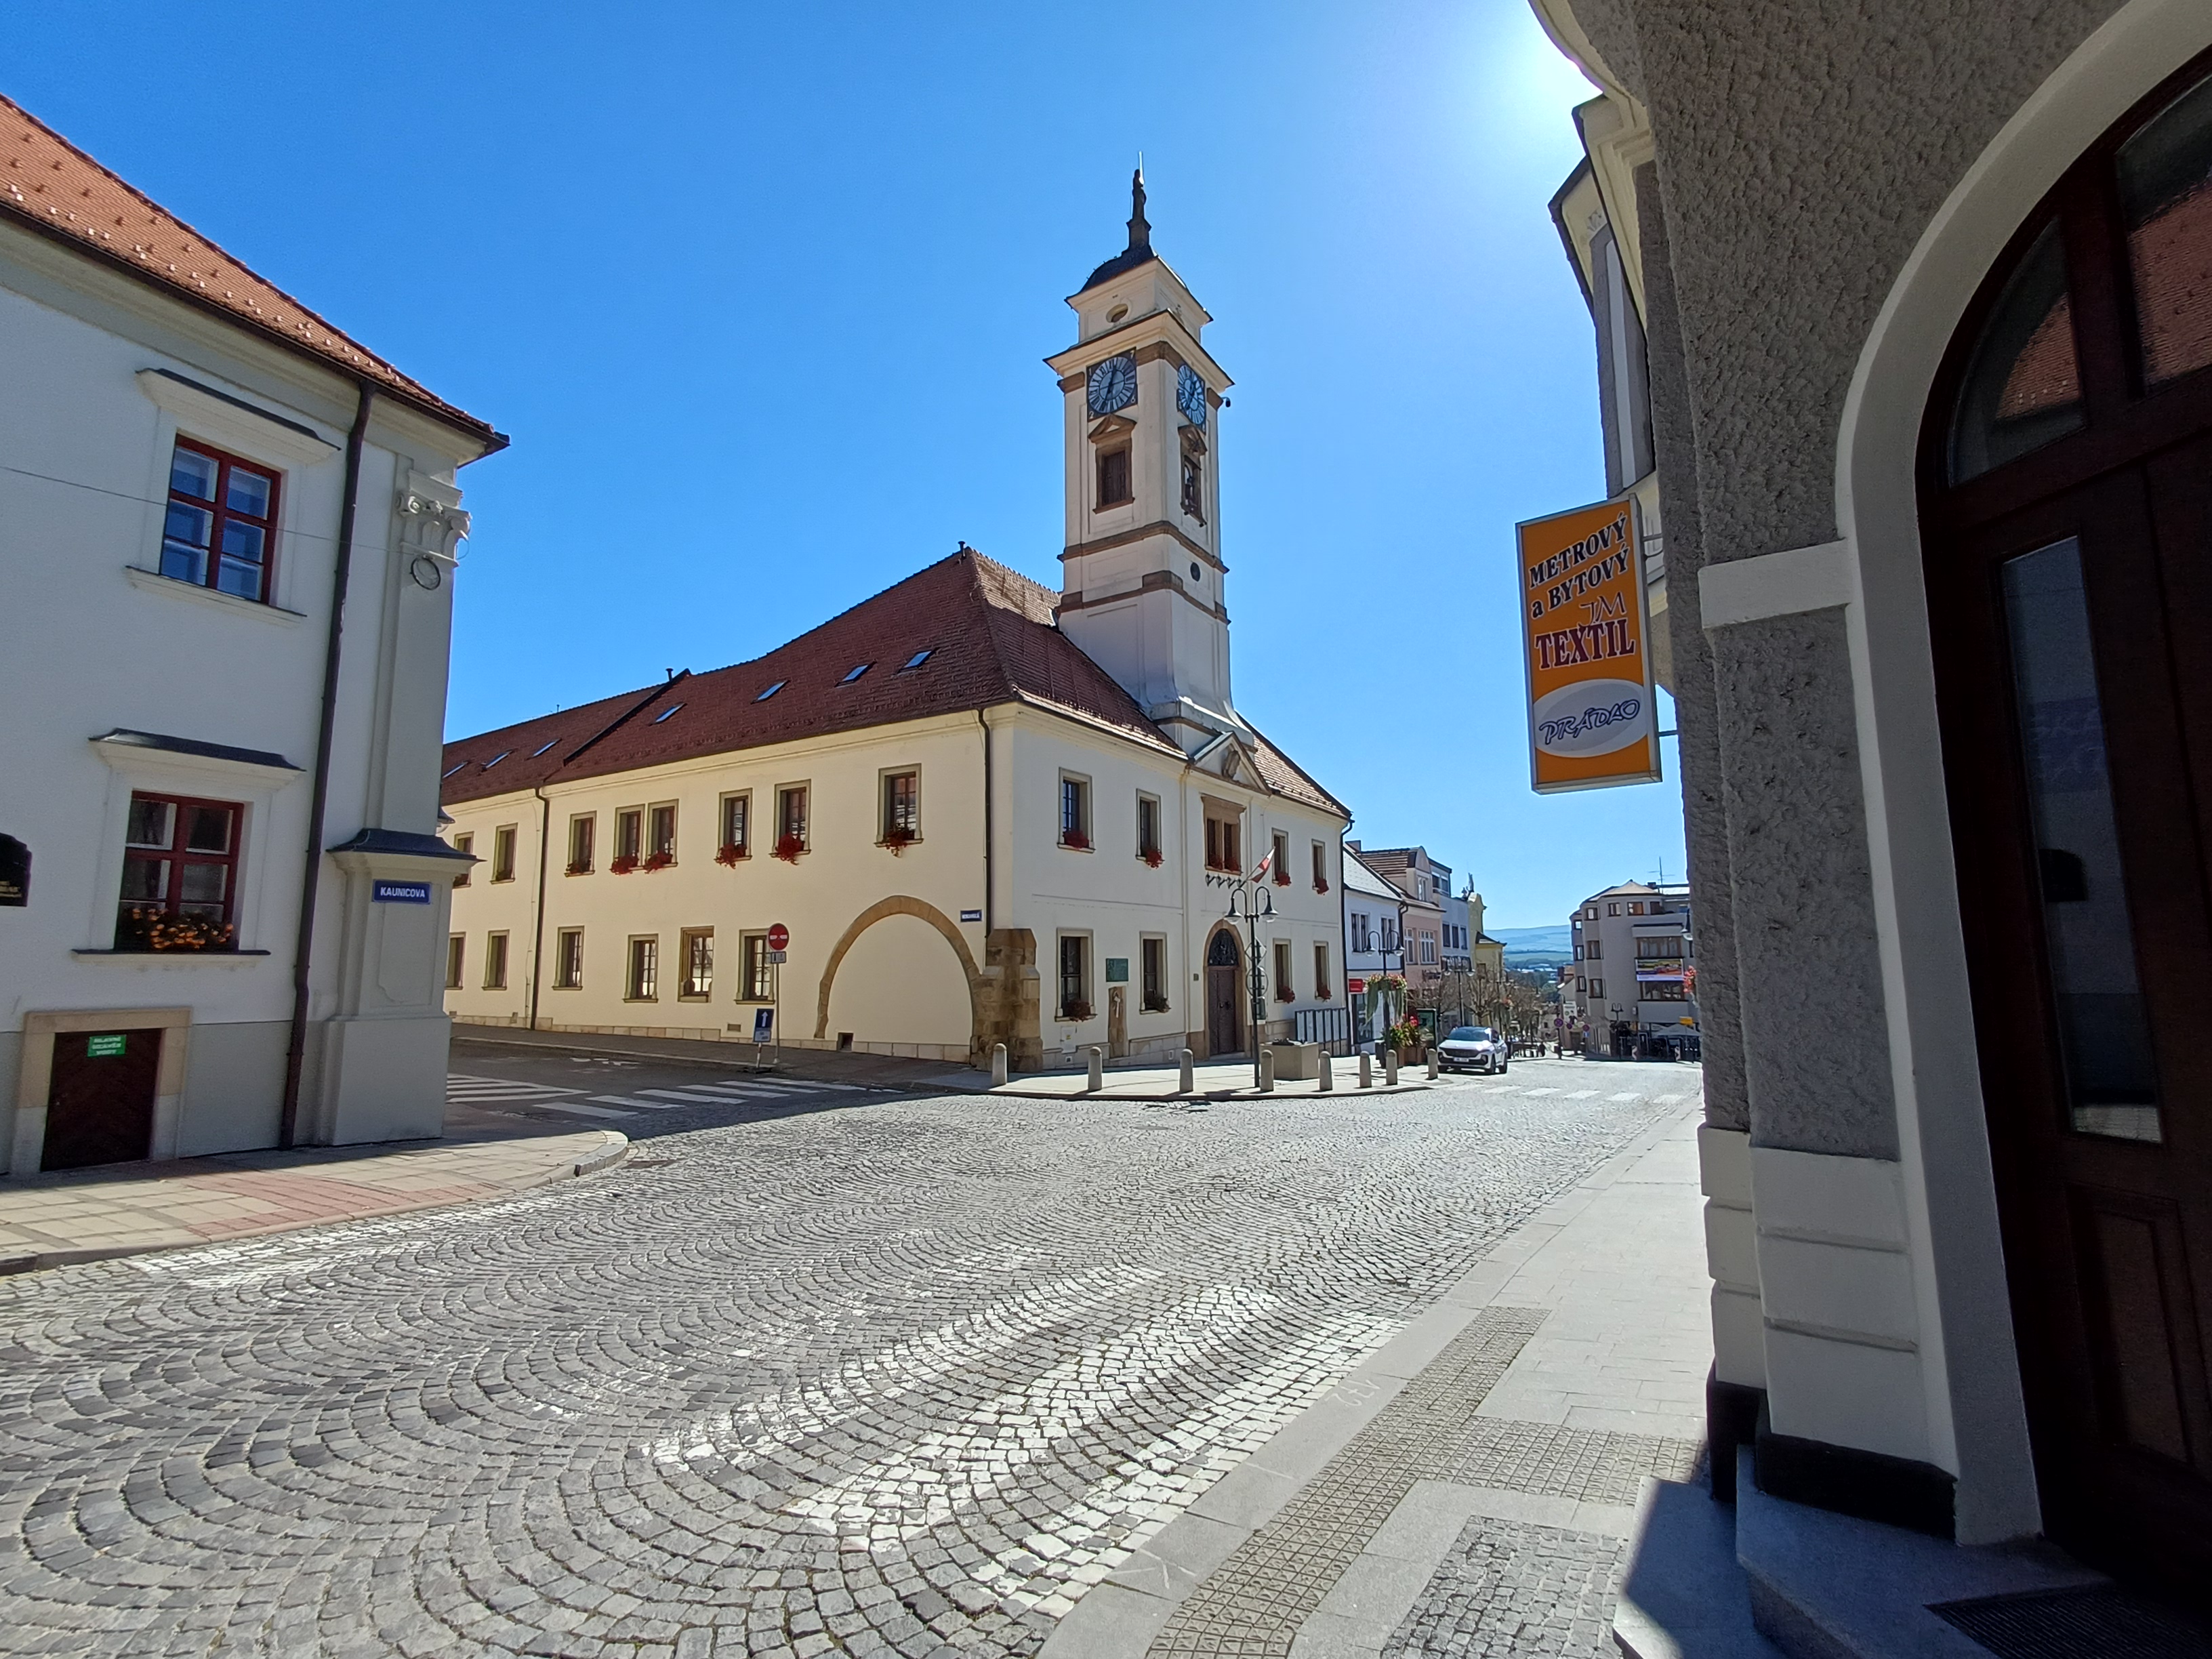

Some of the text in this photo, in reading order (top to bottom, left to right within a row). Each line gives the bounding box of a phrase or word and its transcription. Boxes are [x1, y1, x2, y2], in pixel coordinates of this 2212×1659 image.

[1530, 511, 1628, 590] METROVÝ
[1531, 542, 1631, 619] a BYTOVÝ
[1535, 617, 1636, 671] TEXTIL
[1538, 699, 1640, 745] PRÁDLO
[380, 886, 425, 898] KAUNICOVA
